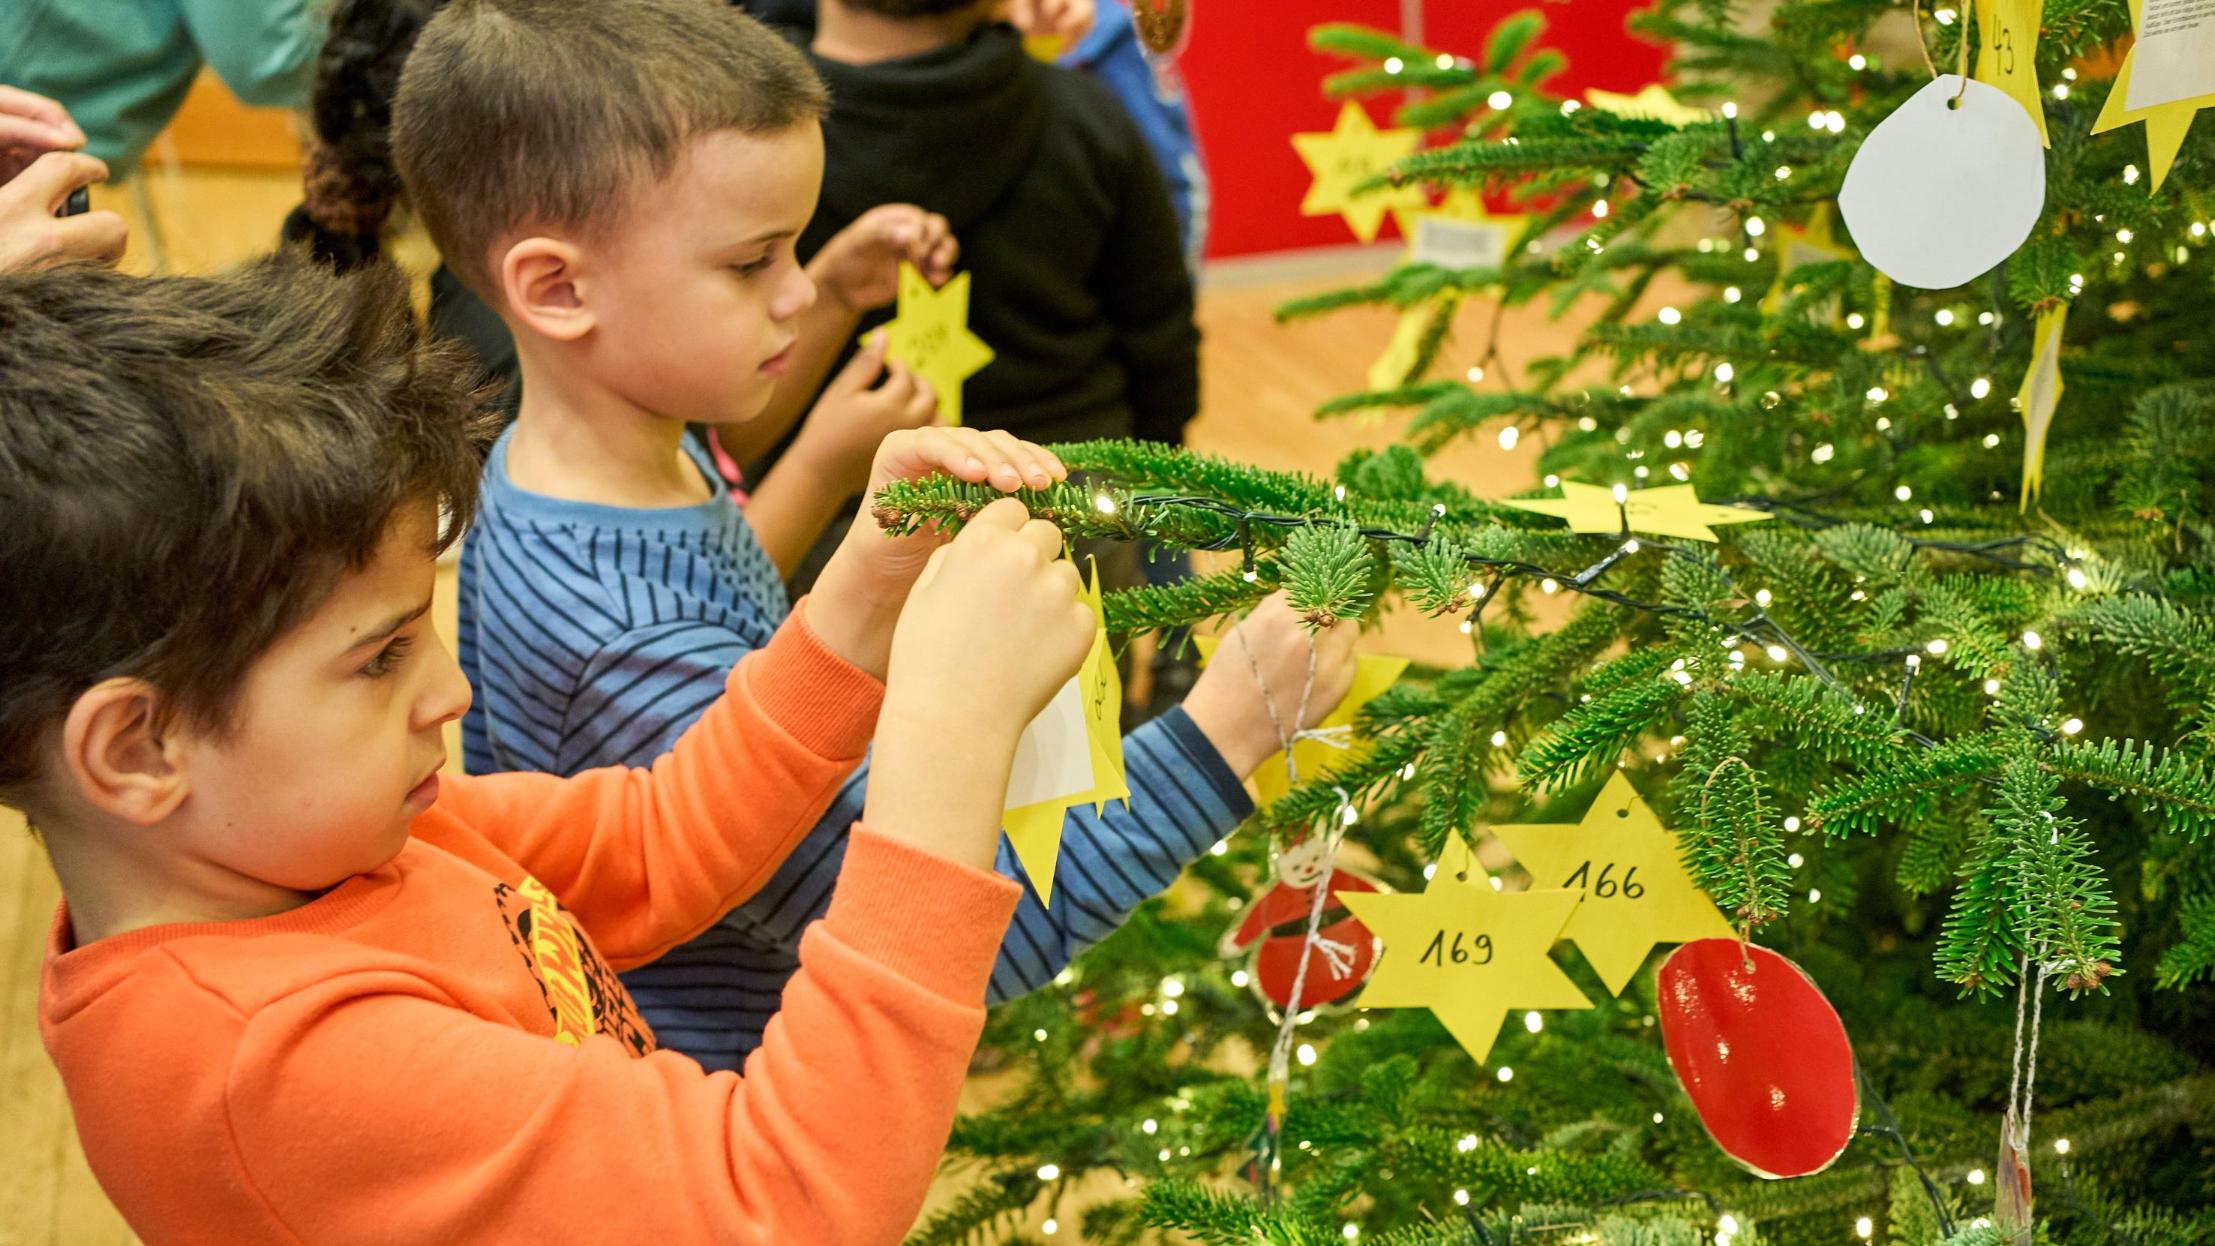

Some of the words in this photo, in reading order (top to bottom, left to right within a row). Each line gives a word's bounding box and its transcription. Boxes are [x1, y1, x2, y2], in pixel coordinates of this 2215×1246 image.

[1992, 13, 2015, 77] 43
[1562, 860, 1645, 902] 166
[1419, 929, 1493, 968] 169
